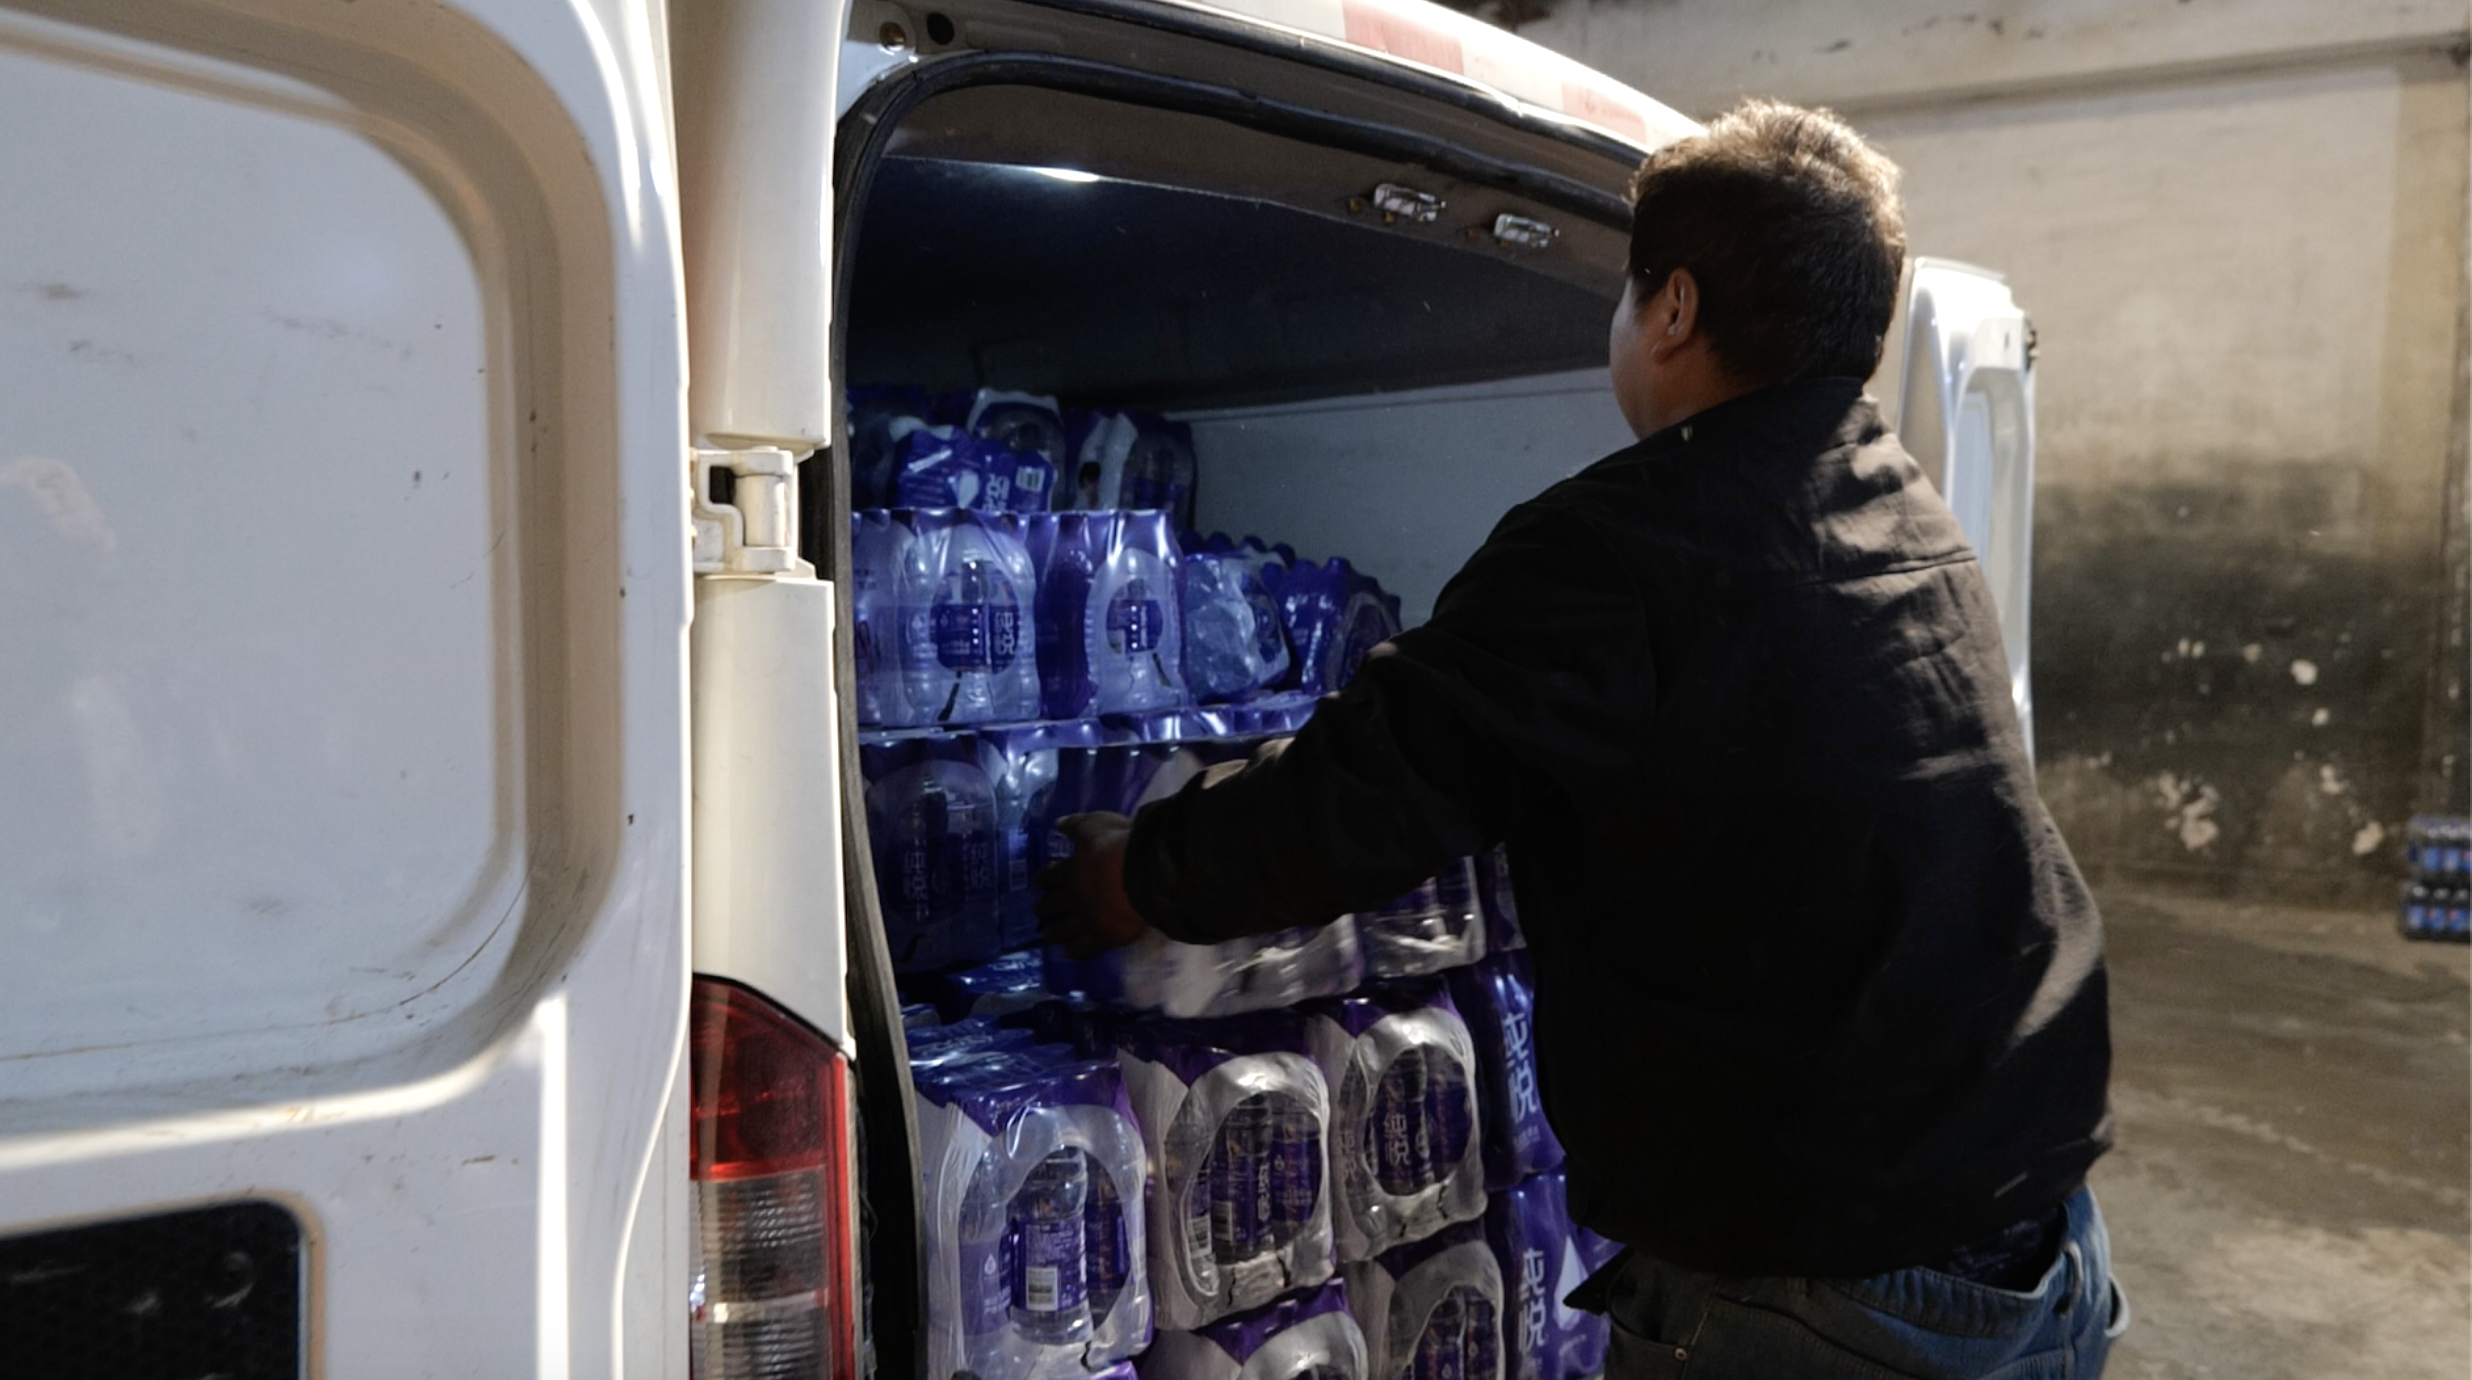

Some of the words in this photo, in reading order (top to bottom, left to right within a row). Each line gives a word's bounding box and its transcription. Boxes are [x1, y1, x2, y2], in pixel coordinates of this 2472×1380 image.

[1503, 1012, 1537, 1124] 纯悦
[1383, 1112, 1411, 1166] 纯悦
[1518, 1247, 1547, 1355] 纯悦
